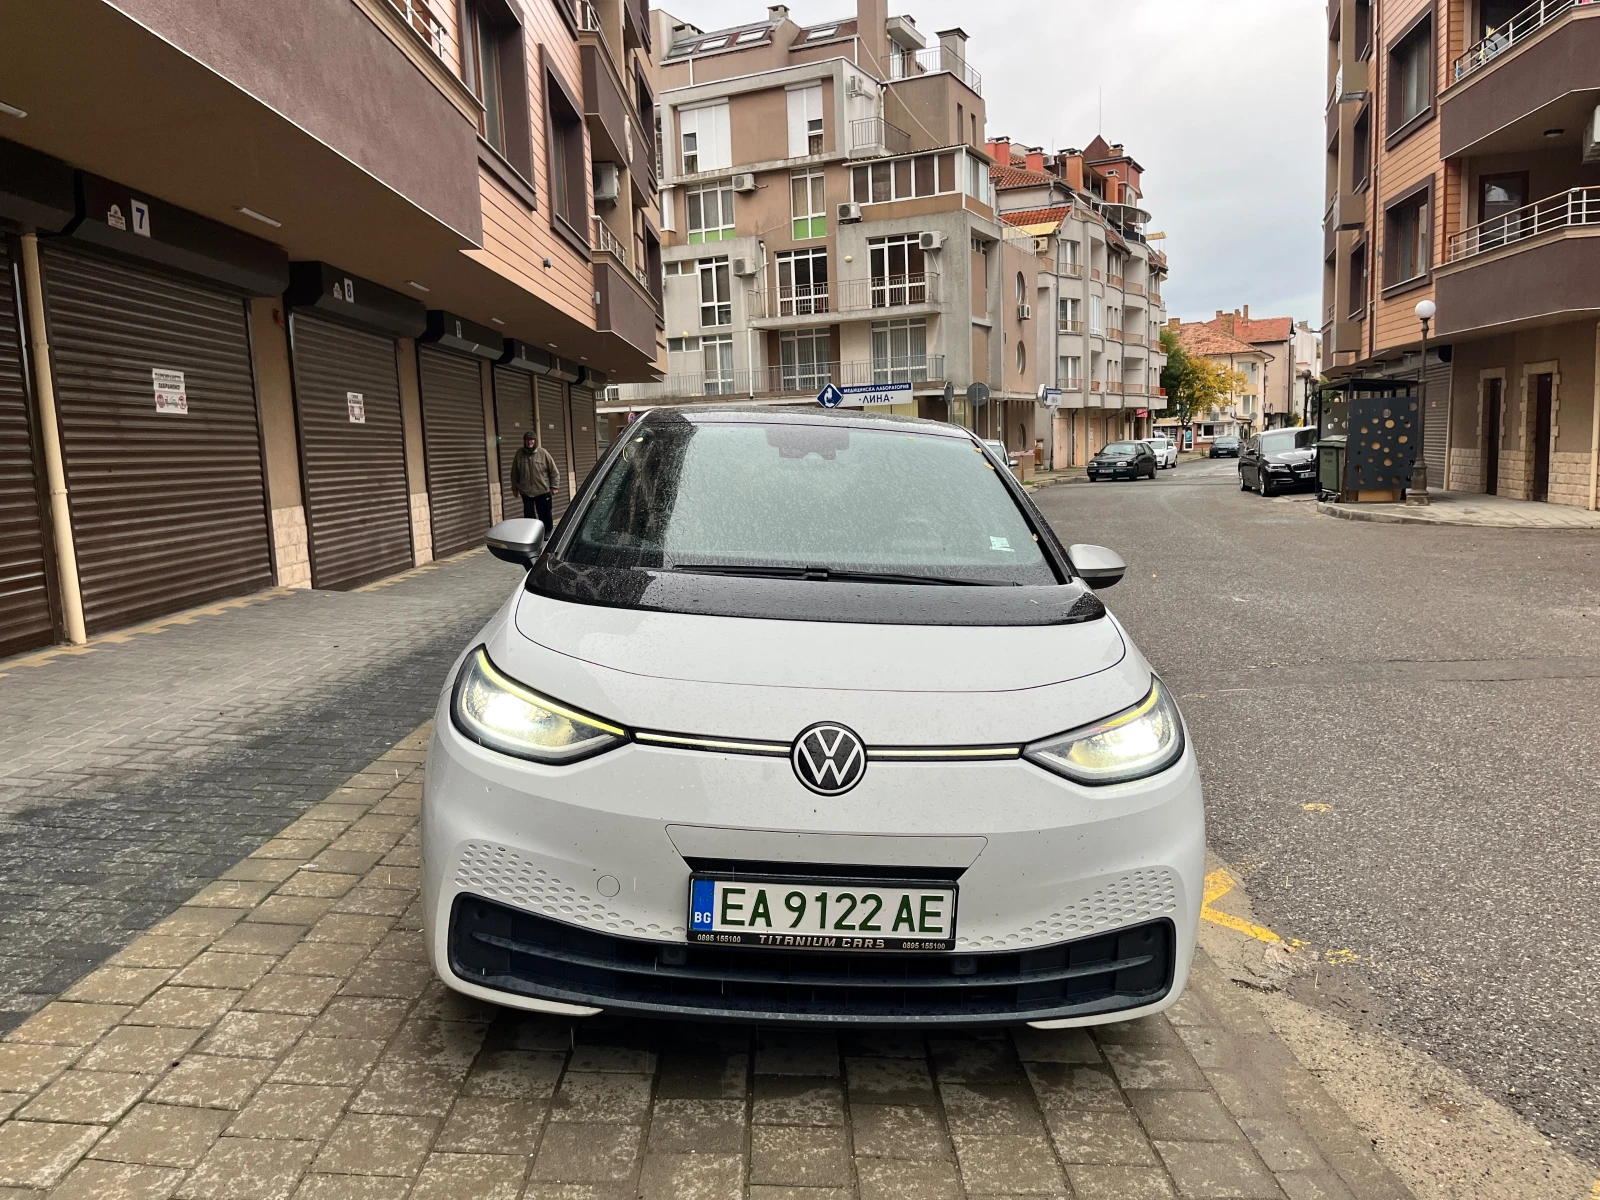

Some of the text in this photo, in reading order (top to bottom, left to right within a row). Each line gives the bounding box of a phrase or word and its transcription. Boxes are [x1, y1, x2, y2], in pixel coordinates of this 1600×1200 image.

[135, 206, 145, 230] 7
[346, 283, 352, 299] 8
[720, 887, 944, 933] EA 9122 AE
[693, 911, 711, 924] BG
[697, 934, 741, 943] 0895 155100
[759, 935, 885, 949] TITANIUM CARS
[902, 941, 946, 950] 0895 155100
